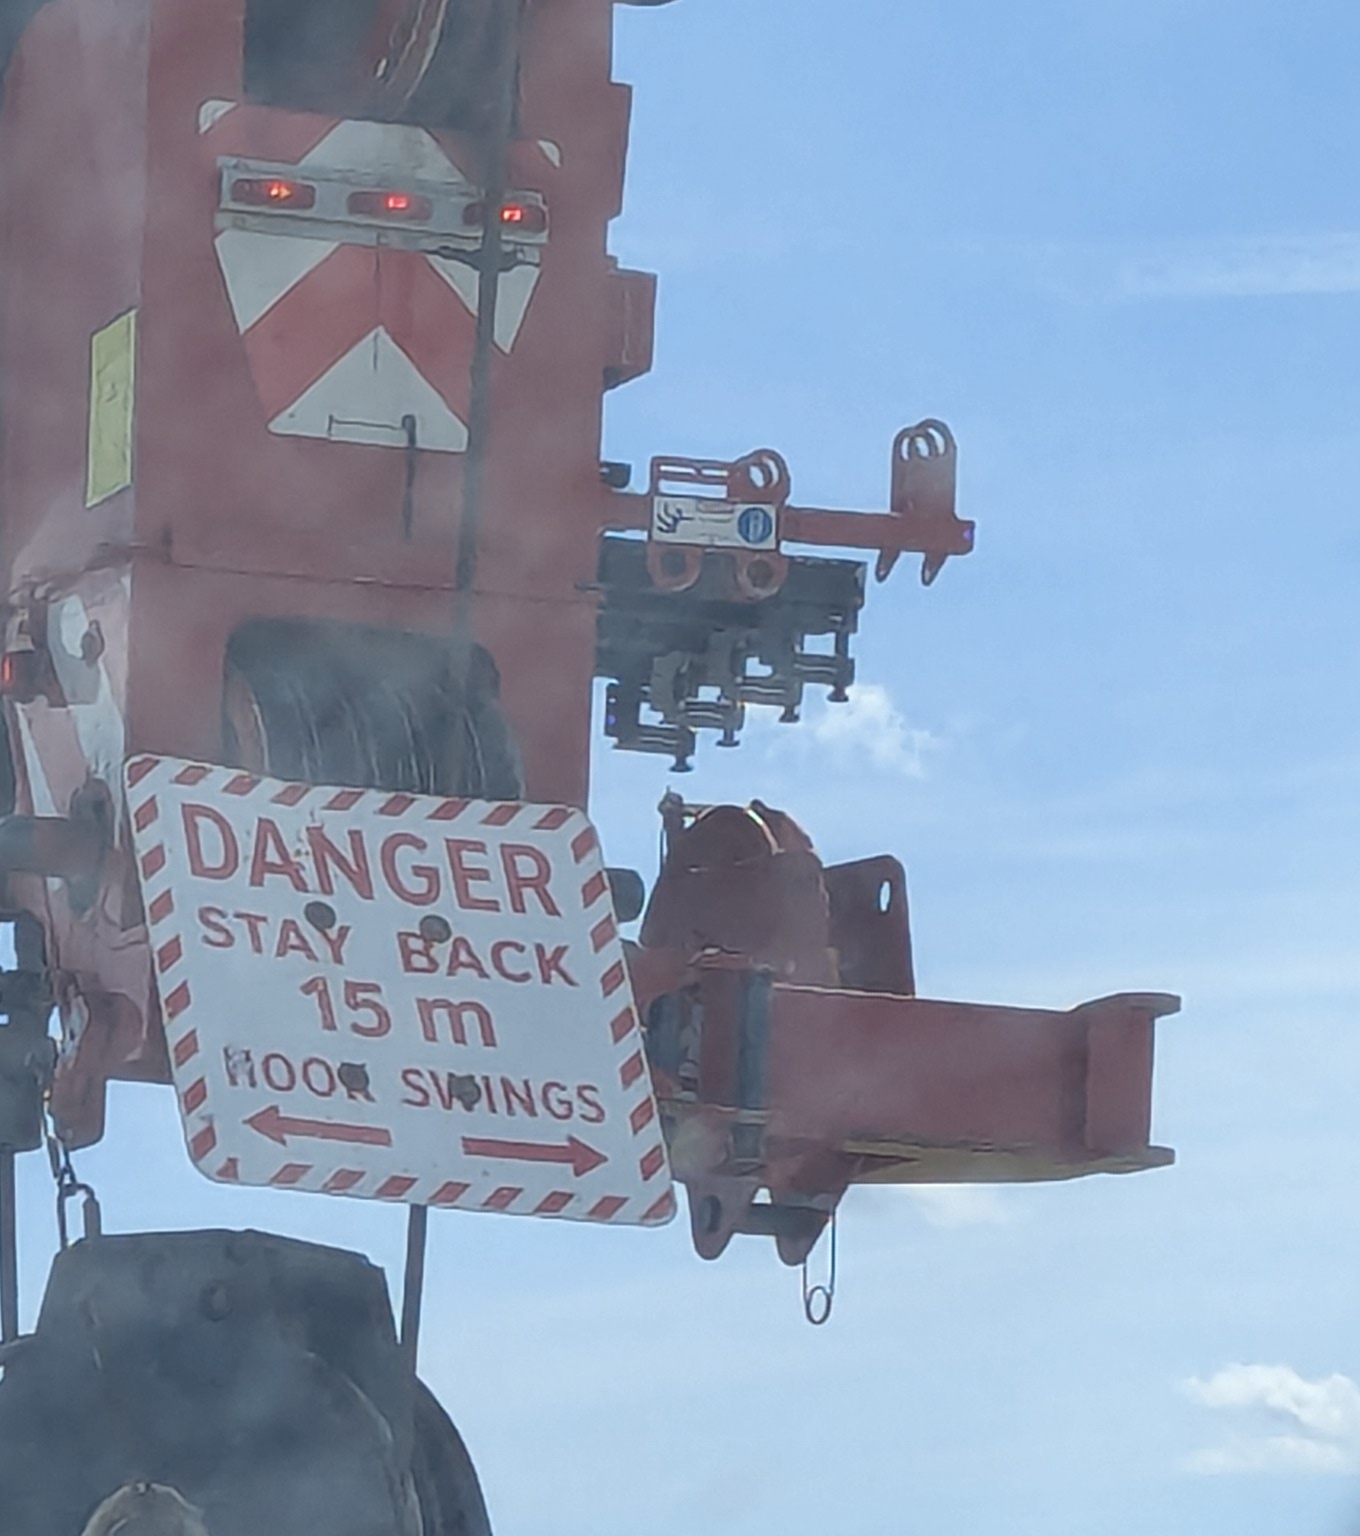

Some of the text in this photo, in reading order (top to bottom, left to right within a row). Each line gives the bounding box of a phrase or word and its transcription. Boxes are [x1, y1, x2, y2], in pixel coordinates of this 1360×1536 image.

[181, 803, 562, 918] DANGER
[197, 906, 580, 987] STAY BACK
[299, 976, 498, 1048] 15 m
